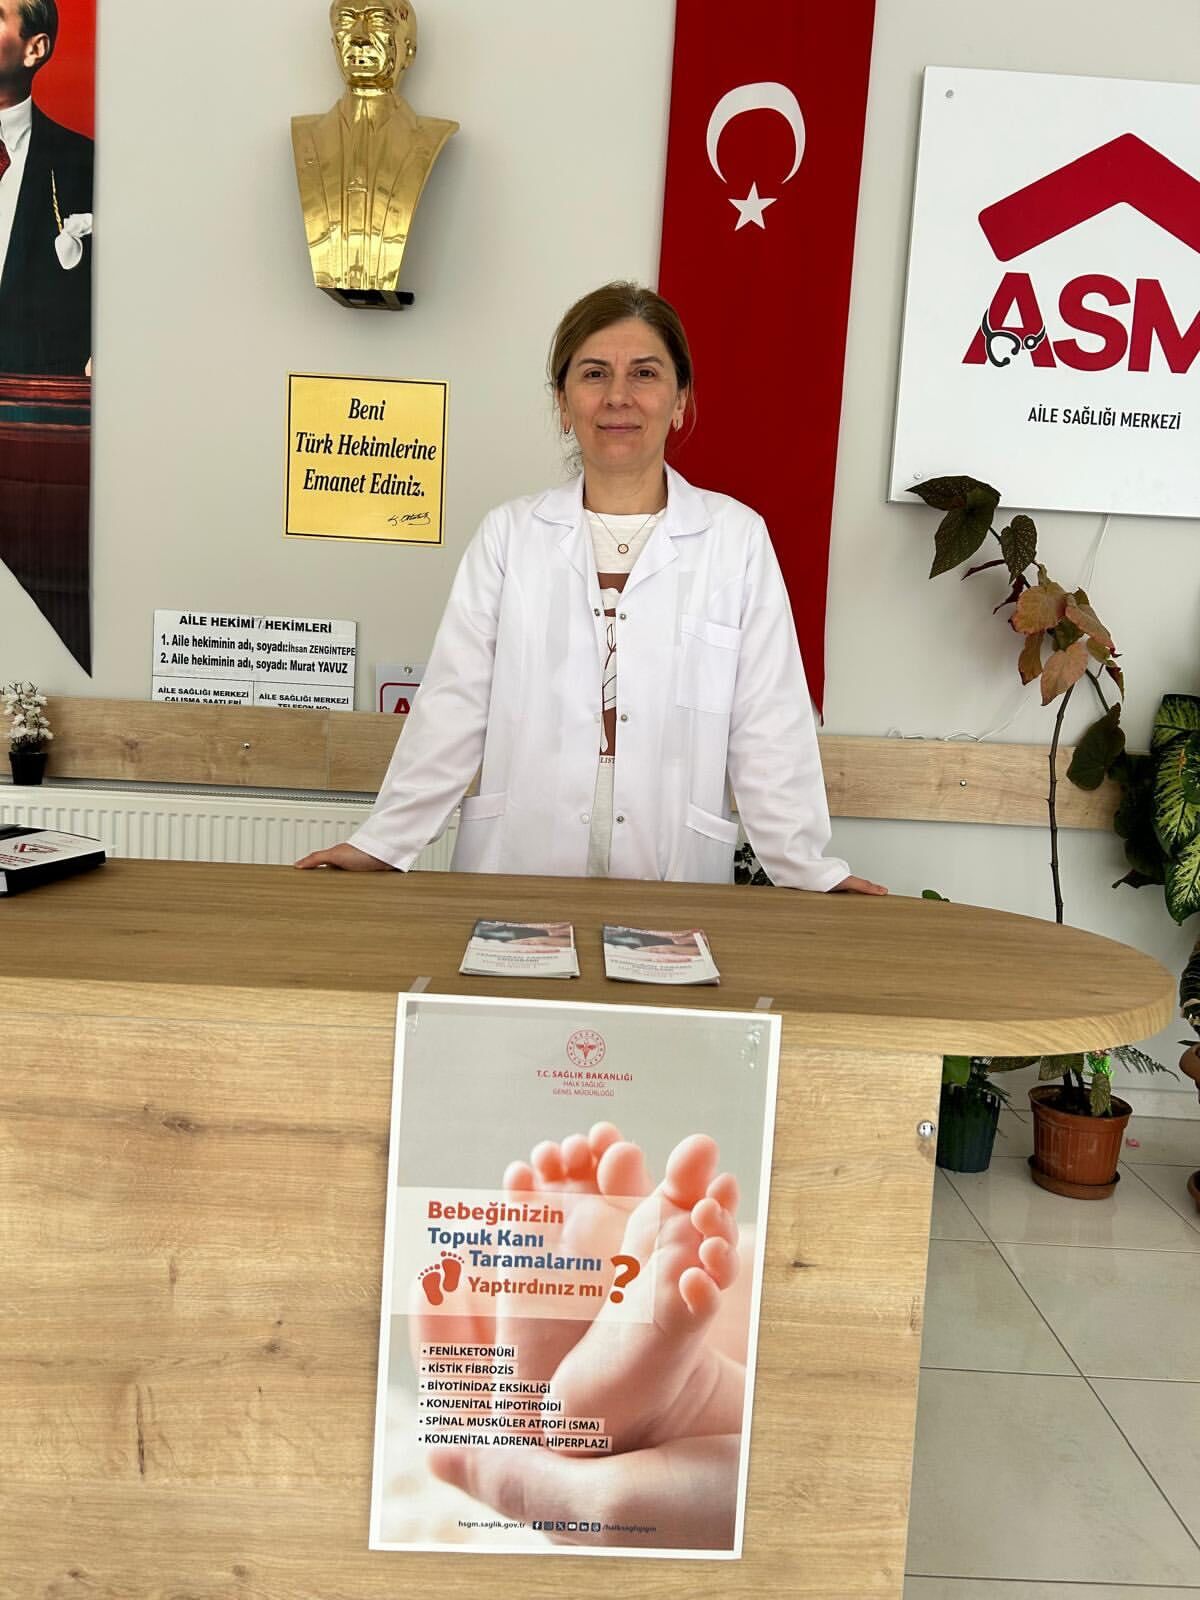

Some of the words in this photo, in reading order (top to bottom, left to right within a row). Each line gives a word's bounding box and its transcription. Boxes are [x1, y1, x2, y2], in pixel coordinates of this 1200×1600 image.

[961, 272, 1200, 374] ASM
[348, 398, 386, 421] Beni
[1027, 404, 1059, 423] AİLE
[1062, 406, 1116, 427] SAĞLIĞI
[1120, 411, 1182, 430] MERKEZİ
[296, 431, 333, 455] Türk
[337, 434, 437, 461] Hekimlerine
[303, 468, 366, 494] Emanet
[370, 473, 425, 497] Ediniz.
[179, 613, 207, 626] AİLE
[211, 616, 255, 629] HEKİMİ
[265, 619, 332, 633] HEKİMLERİ
[161, 633, 169, 646] 1.
[172, 634, 190, 647] Aile
[192, 635, 235, 649] hekiminin
[238, 638, 254, 652] adı,
[160, 652, 169, 664] 2.
[171, 653, 189, 665] Aile
[192, 654, 235, 668] hekiminin
[237, 657, 253, 671] adı,
[256, 659, 287, 672] soyadı:
[290, 660, 315, 672] Murat
[318, 661, 348, 674] YAVUZ
[158, 686, 176, 694] AİLE
[178, 687, 211, 696] SAĞLIĞI
[213, 690, 249, 698] MERKEZİ
[279, 694, 312, 702] SAĞLIĞI
[552, 1069, 582, 1079] SAĞLIK
[428, 1200, 564, 1226] Bebeğinizin
[427, 1227, 492, 1248] Topuk
[498, 1229, 544, 1248] Kanı
[469, 1250, 601, 1271] Taramalarını
[467, 1276, 575, 1298] Yaptırdınız
[579, 1284, 603, 1297] mı
[429, 1345, 515, 1358] FENİLKETONÜRİ
[428, 1362, 463, 1374] KİSTİK
[465, 1363, 514, 1375] FİBROZİS
[427, 1380, 497, 1392] BİYOTİNİDAZ
[499, 1381, 551, 1395] EKSİKLİĞİ
[426, 1397, 492, 1410] KONJENİTAL
[495, 1399, 562, 1412] HİPOTİROİDİ
[425, 1415, 464, 1427] SPİNAL
[467, 1416, 526, 1429] MUSKÜLER
[528, 1418, 566, 1430] ATROFİ
[568, 1420, 600, 1432] (SMA)
[424, 1432, 490, 1445] KONJENİTAL
[493, 1435, 544, 1447] ADRENAL
[546, 1435, 609, 1449] HİPERPLAZİ
